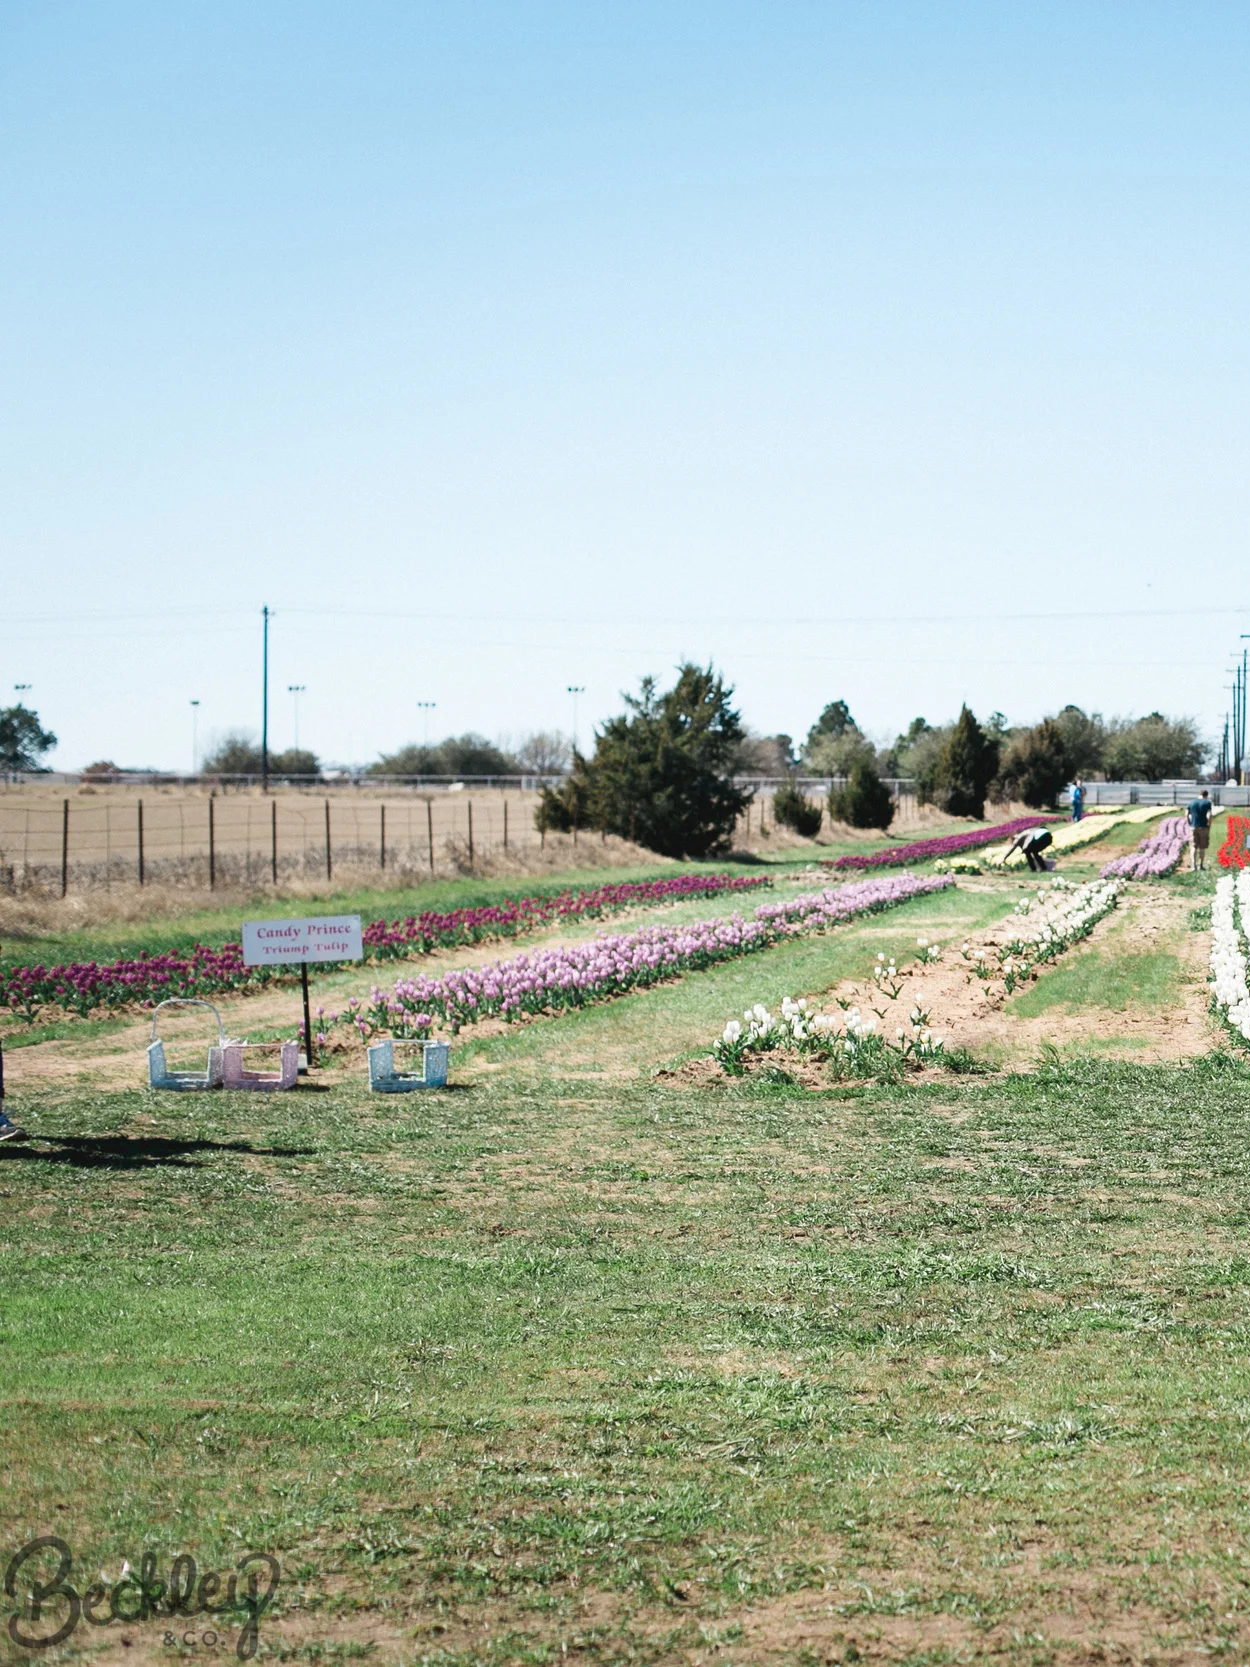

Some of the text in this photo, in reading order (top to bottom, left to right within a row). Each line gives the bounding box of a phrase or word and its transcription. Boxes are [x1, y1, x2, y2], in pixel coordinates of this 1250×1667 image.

[257, 924, 351, 941] Candy Prince
[263, 942, 348, 955] Triump Tulip
